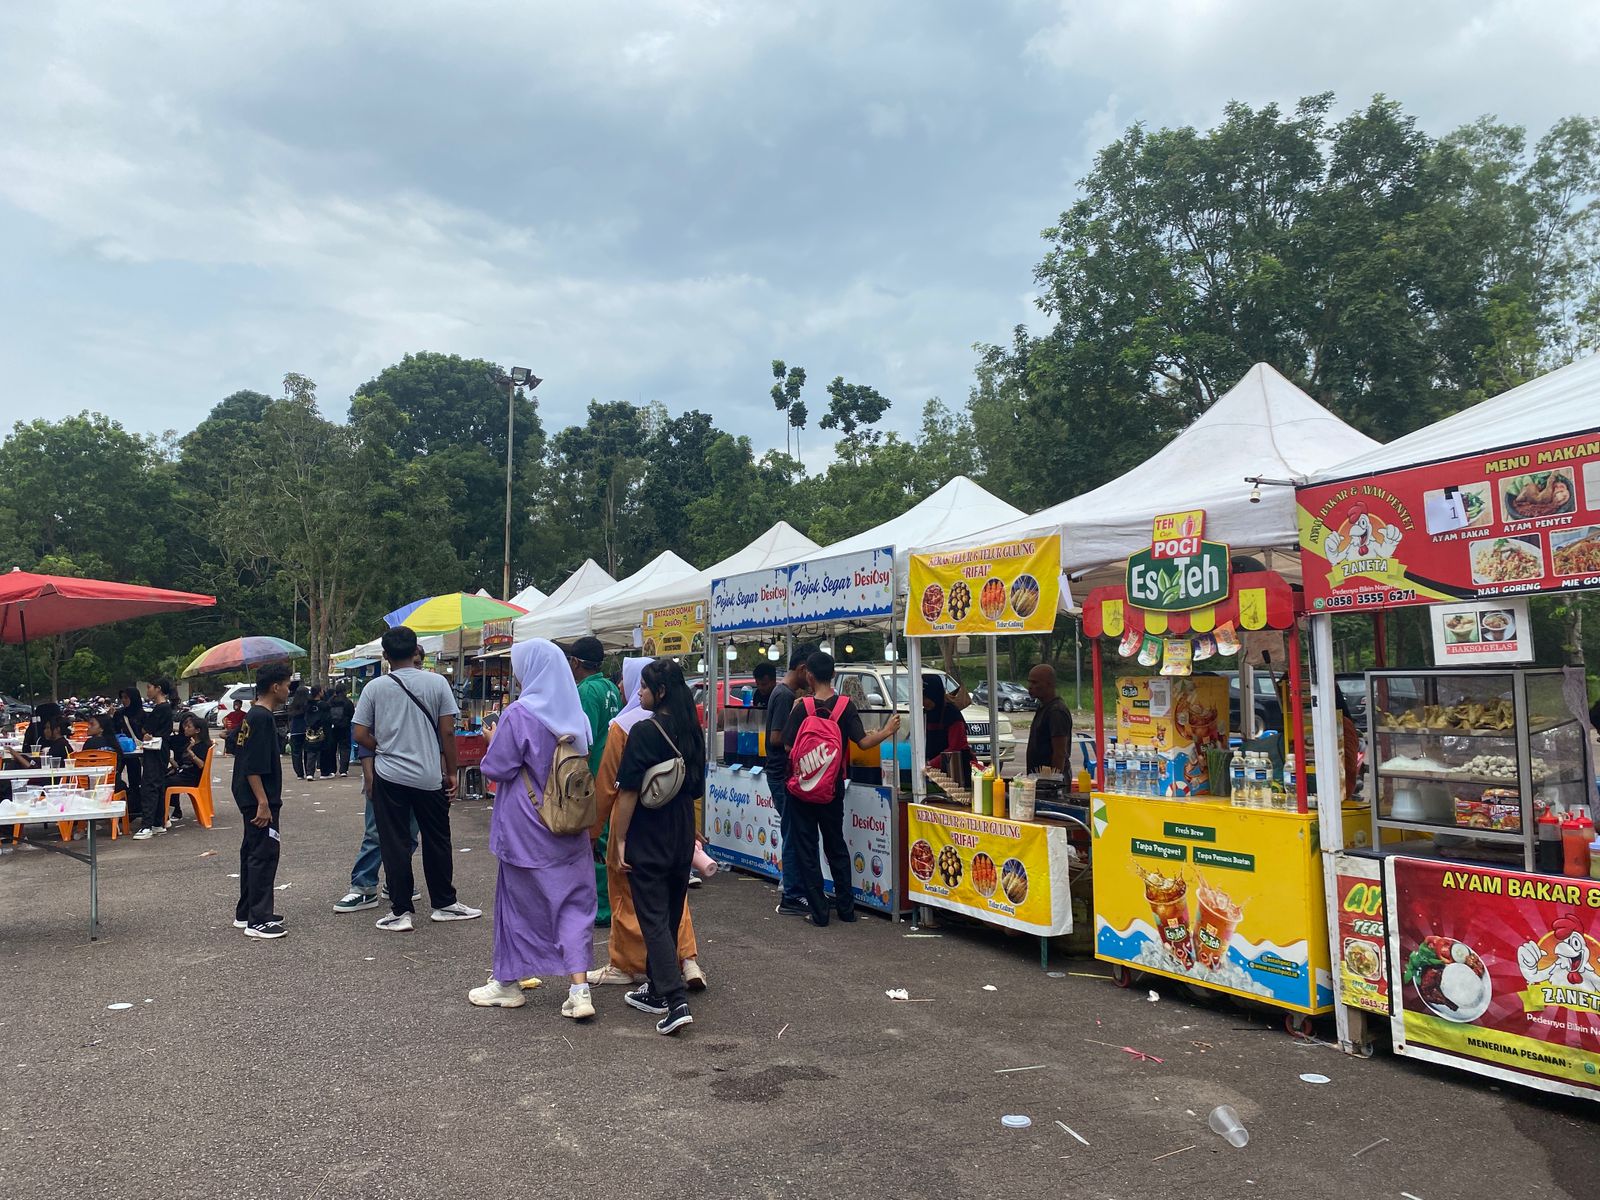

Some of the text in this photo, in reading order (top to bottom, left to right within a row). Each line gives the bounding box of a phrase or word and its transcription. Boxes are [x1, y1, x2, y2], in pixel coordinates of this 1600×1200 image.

[1485, 441, 1600, 474] MENU MAKAN
[1320, 489, 1348, 516] BAKAR
[1350, 486, 1357, 496] &
[1361, 485, 1387, 499] AYAM
[1386, 493, 1415, 531] PENYET
[1449, 506, 1459, 520] 1
[1156, 518, 1174, 530] TEH
[1503, 516, 1573, 532] AYAM PENYET
[1432, 529, 1490, 543] AYAM BAKAR
[980, 548, 1002, 560] TELUR
[1003, 542, 1035, 557] GULUNG
[1155, 538, 1198, 557] POCI
[1132, 554, 1219, 600] Es Teh
[1341, 559, 1388, 577] ZANETA
[793, 579, 820, 598] Pojok
[821, 576, 852, 596] Segar
[1477, 583, 1541, 596] NASI GORENG
[1561, 578, 1580, 588] MIE
[715, 595, 735, 613] Pojok
[736, 592, 759, 609] Segar
[1326, 589, 1416, 607] 0858 3555 6271
[1452, 643, 1513, 653] BAKSO GELAS
[799, 742, 832, 777] NIKE
[709, 784, 773, 809] Pojok Segar DesiO
[966, 818, 989, 832] TELUR
[990, 821, 1020, 839] GULUNG
[1175, 826, 1204, 836] Fresh Brew
[1136, 841, 1181, 858] Tanpa Pengawet
[1197, 851, 1212, 860] Tanpa
[1343, 882, 1383, 916] AY
[1442, 871, 1600, 908] AYAM BAKAR &
[1541, 987, 1600, 1011] ZANET
[1526, 1013, 1565, 1029] Pedesnya
[1567, 1023, 1588, 1033] Bikin
[1467, 1037, 1567, 1067] MENERIMA PESANAN
